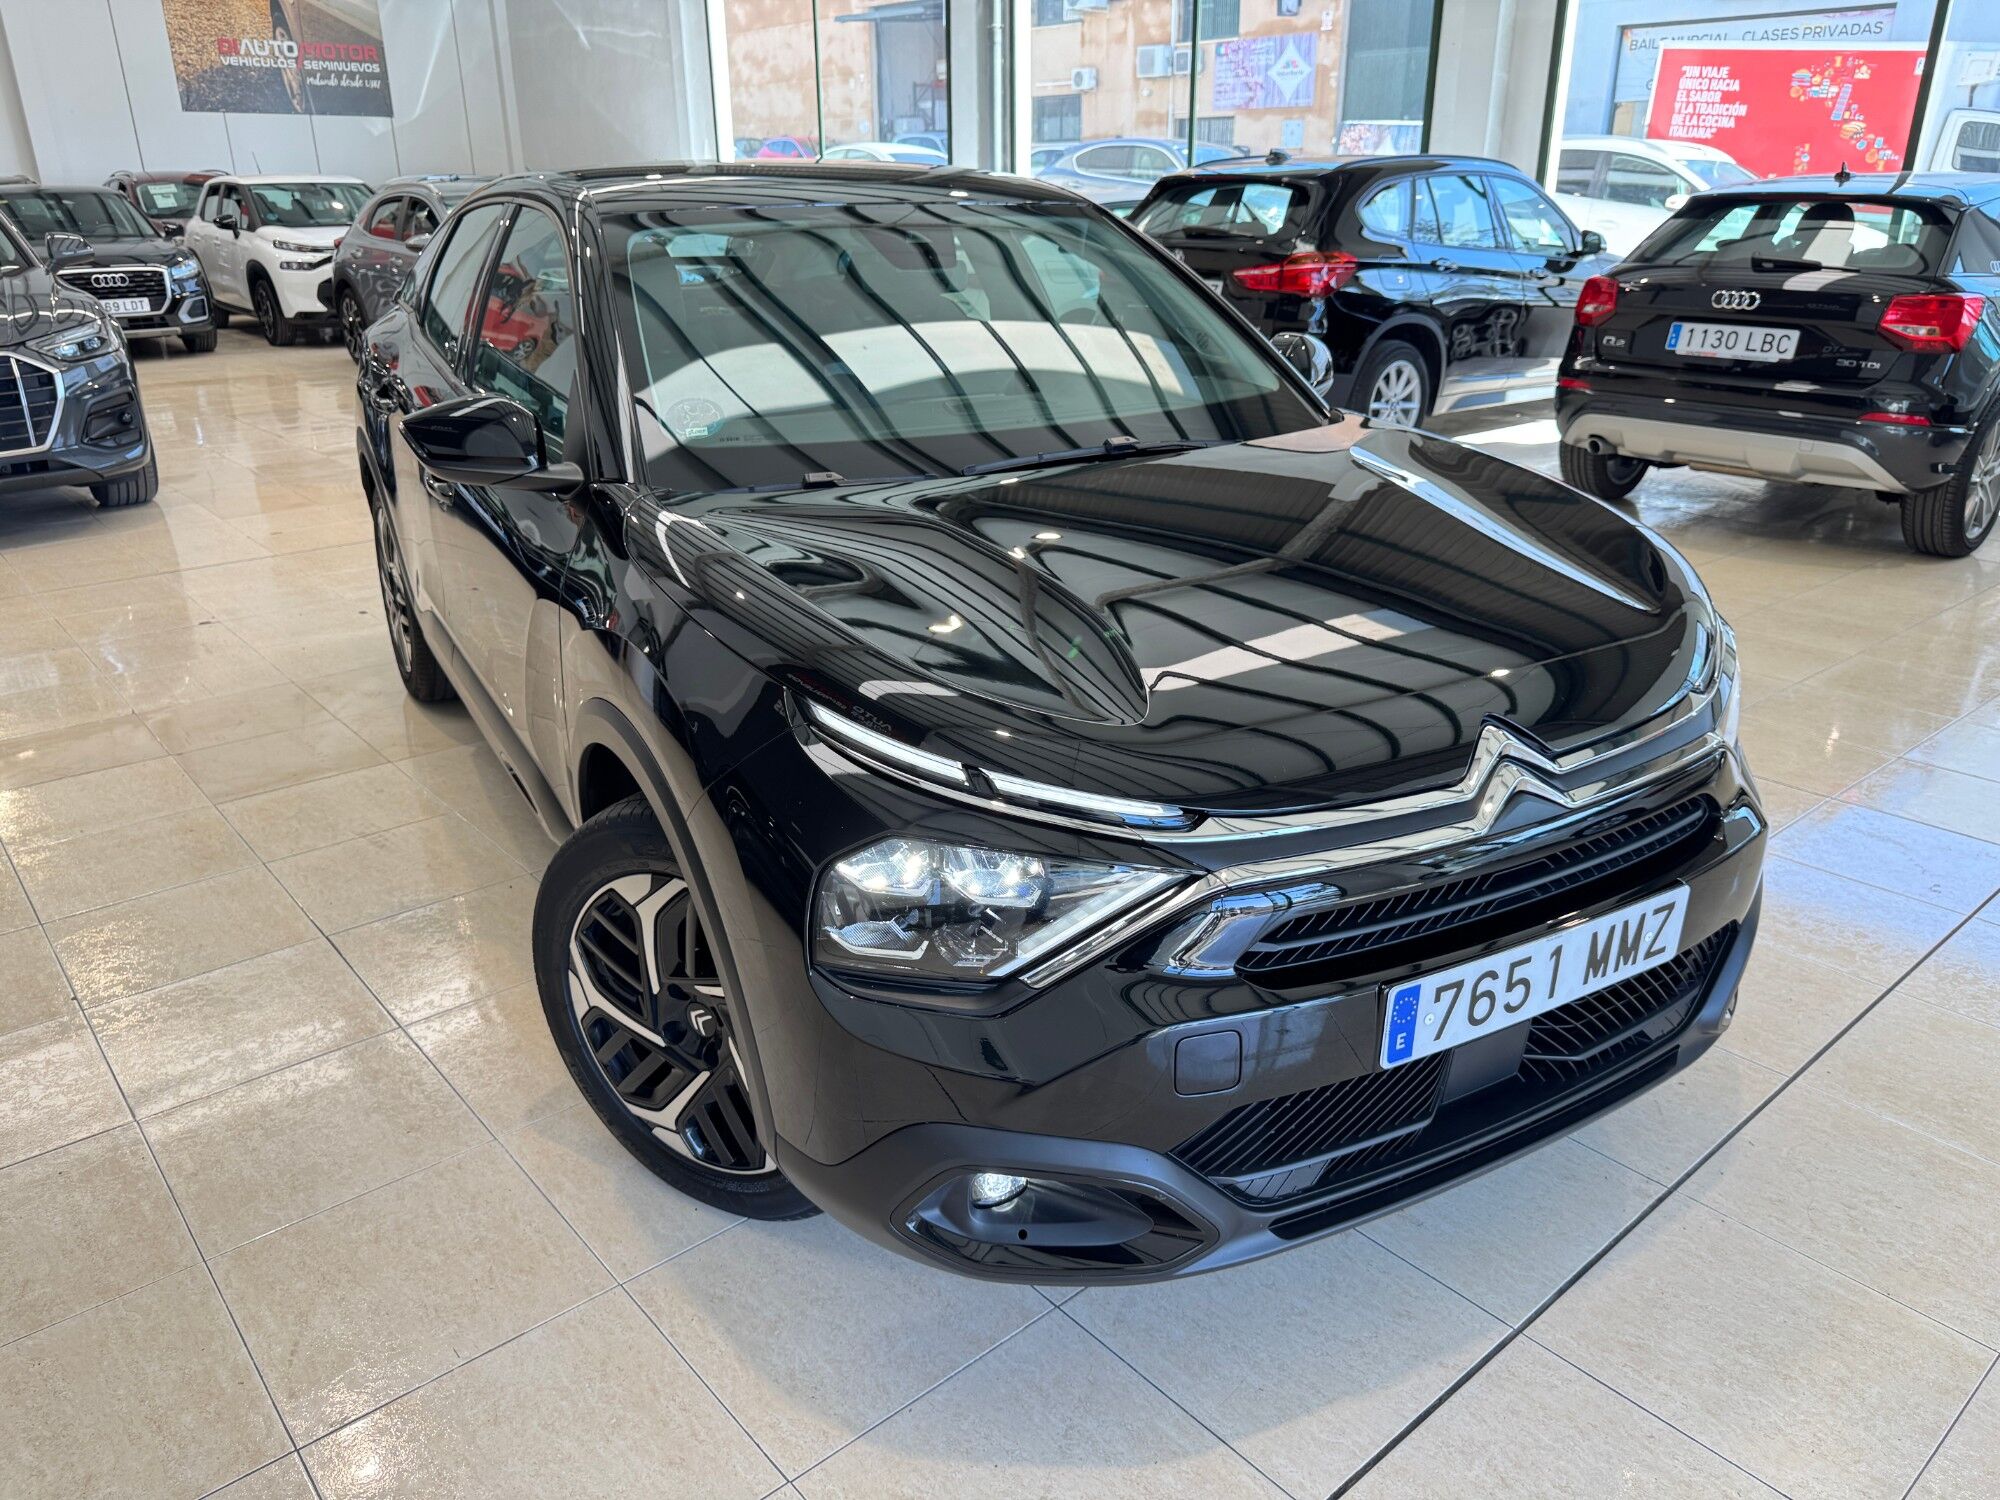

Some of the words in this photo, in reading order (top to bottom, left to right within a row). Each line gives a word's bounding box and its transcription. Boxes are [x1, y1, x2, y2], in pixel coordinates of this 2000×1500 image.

[1629, 37, 1666, 51] BAIL
[1741, 27, 1799, 41] CLASES
[1802, 21, 1884, 40] PRIVADAS
[303, 59, 380, 73] SEMINUEVOS
[1702, 66, 1730, 78] VIAJE
[1710, 79, 1740, 91] HACIA
[1676, 90, 1688, 101] EL
[1689, 90, 1722, 103] SABOR
[1674, 102, 1681, 113] Y
[1681, 102, 1694, 114] LA
[1695, 101, 1748, 117] TRADICIÓN
[1671, 113, 1685, 126] DE
[1685, 114, 1698, 126] LA
[1699, 115, 1735, 128] COCINA
[123, 300, 145, 311] LDT
[1602, 335, 1626, 348] Q2
[1686, 328, 1738, 350] 1130
[1744, 331, 1791, 354] LBC
[1836, 358, 1857, 367] 30
[1859, 360, 1881, 370] TDI
[1433, 944, 1563, 1041] 7651
[1582, 901, 1677, 985] MMZ
[1395, 1032, 1408, 1050] E
